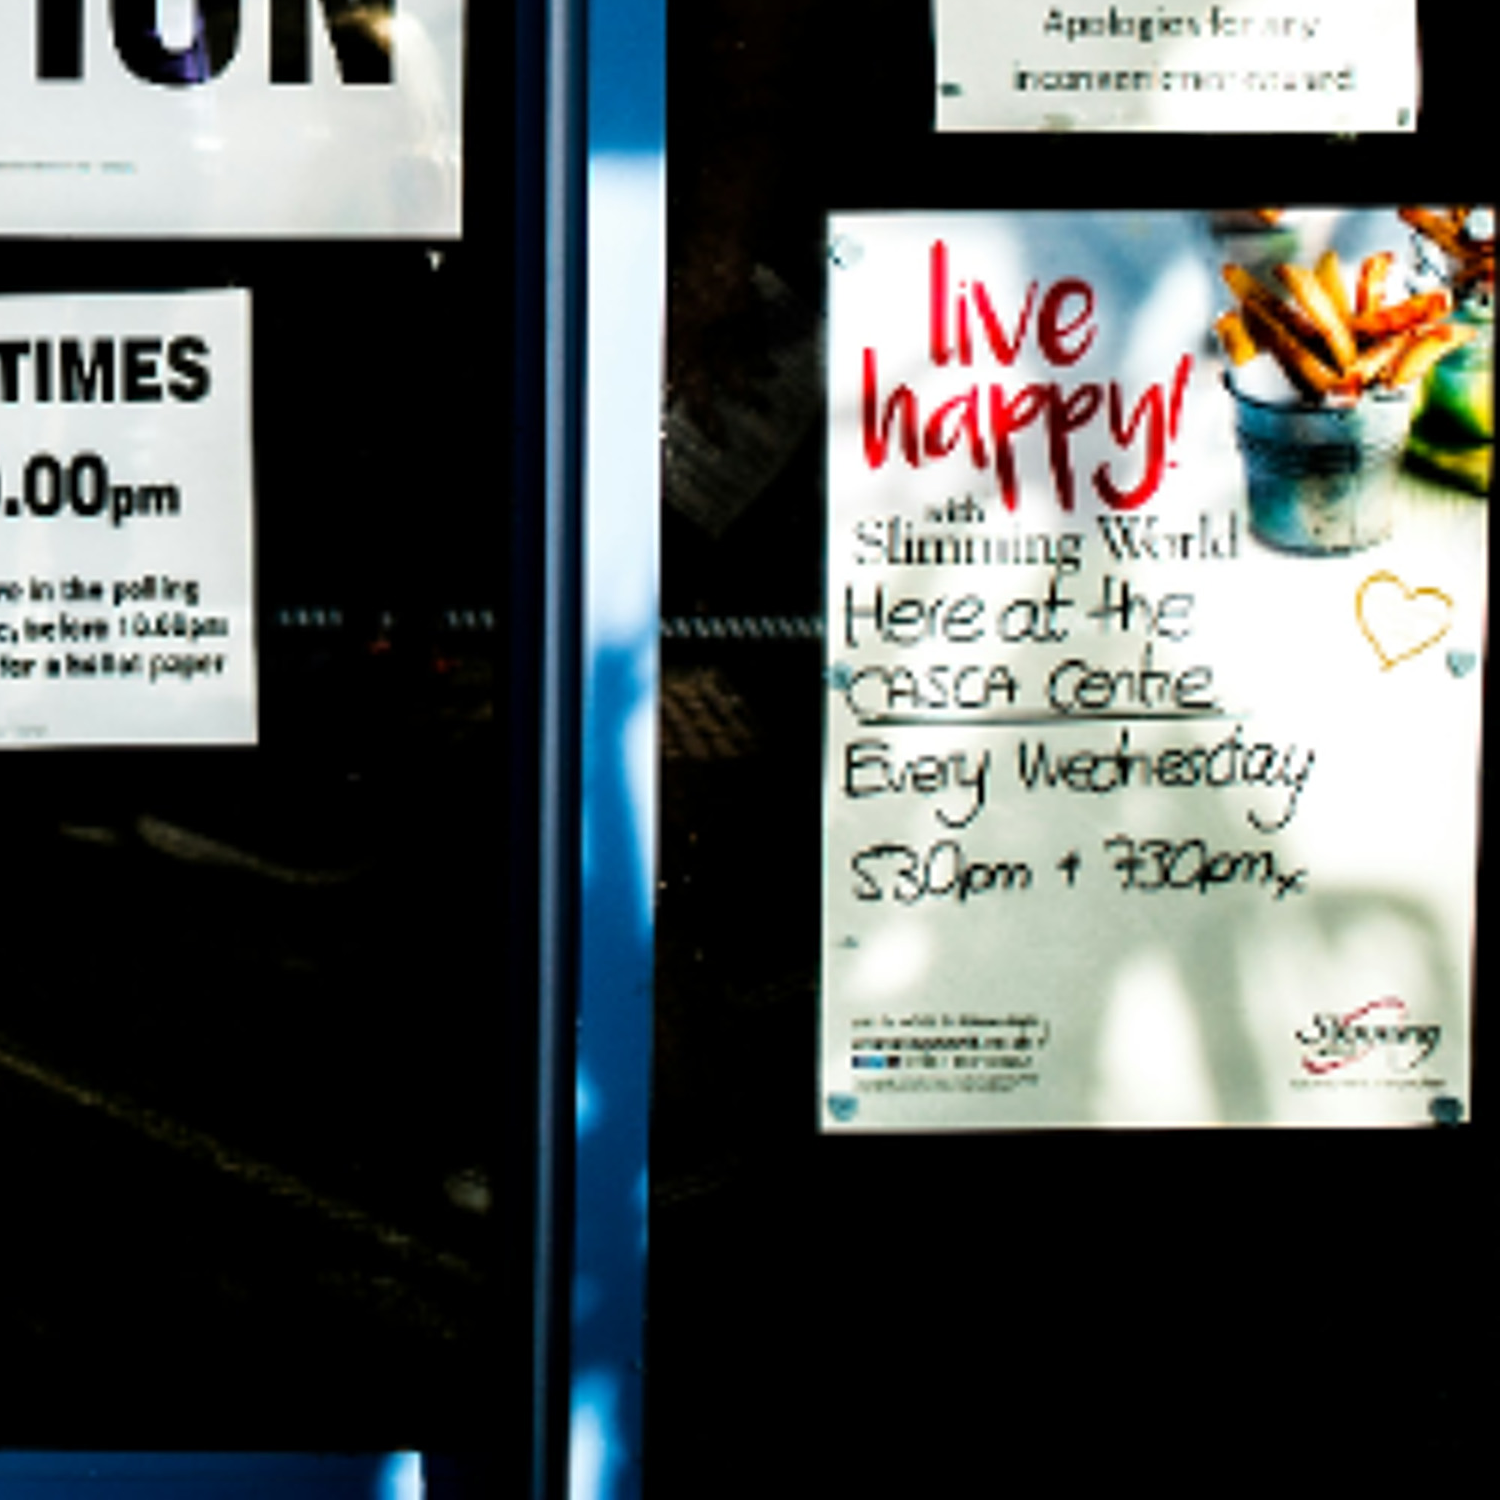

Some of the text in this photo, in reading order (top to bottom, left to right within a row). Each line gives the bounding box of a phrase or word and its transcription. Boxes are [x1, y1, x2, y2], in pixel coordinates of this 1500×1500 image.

[1044, 5, 1200, 43] Apologies
[928, 238, 1098, 367] live
[861, 346, 1194, 512] happy!
[853, 510, 1240, 576] Slimming World
[112, 574, 199, 607] polling
[843, 572, 1196, 648] Here at the
[845, 640, 1226, 720] CASCA Centre
[843, 722, 1316, 834] Every Wednesday
